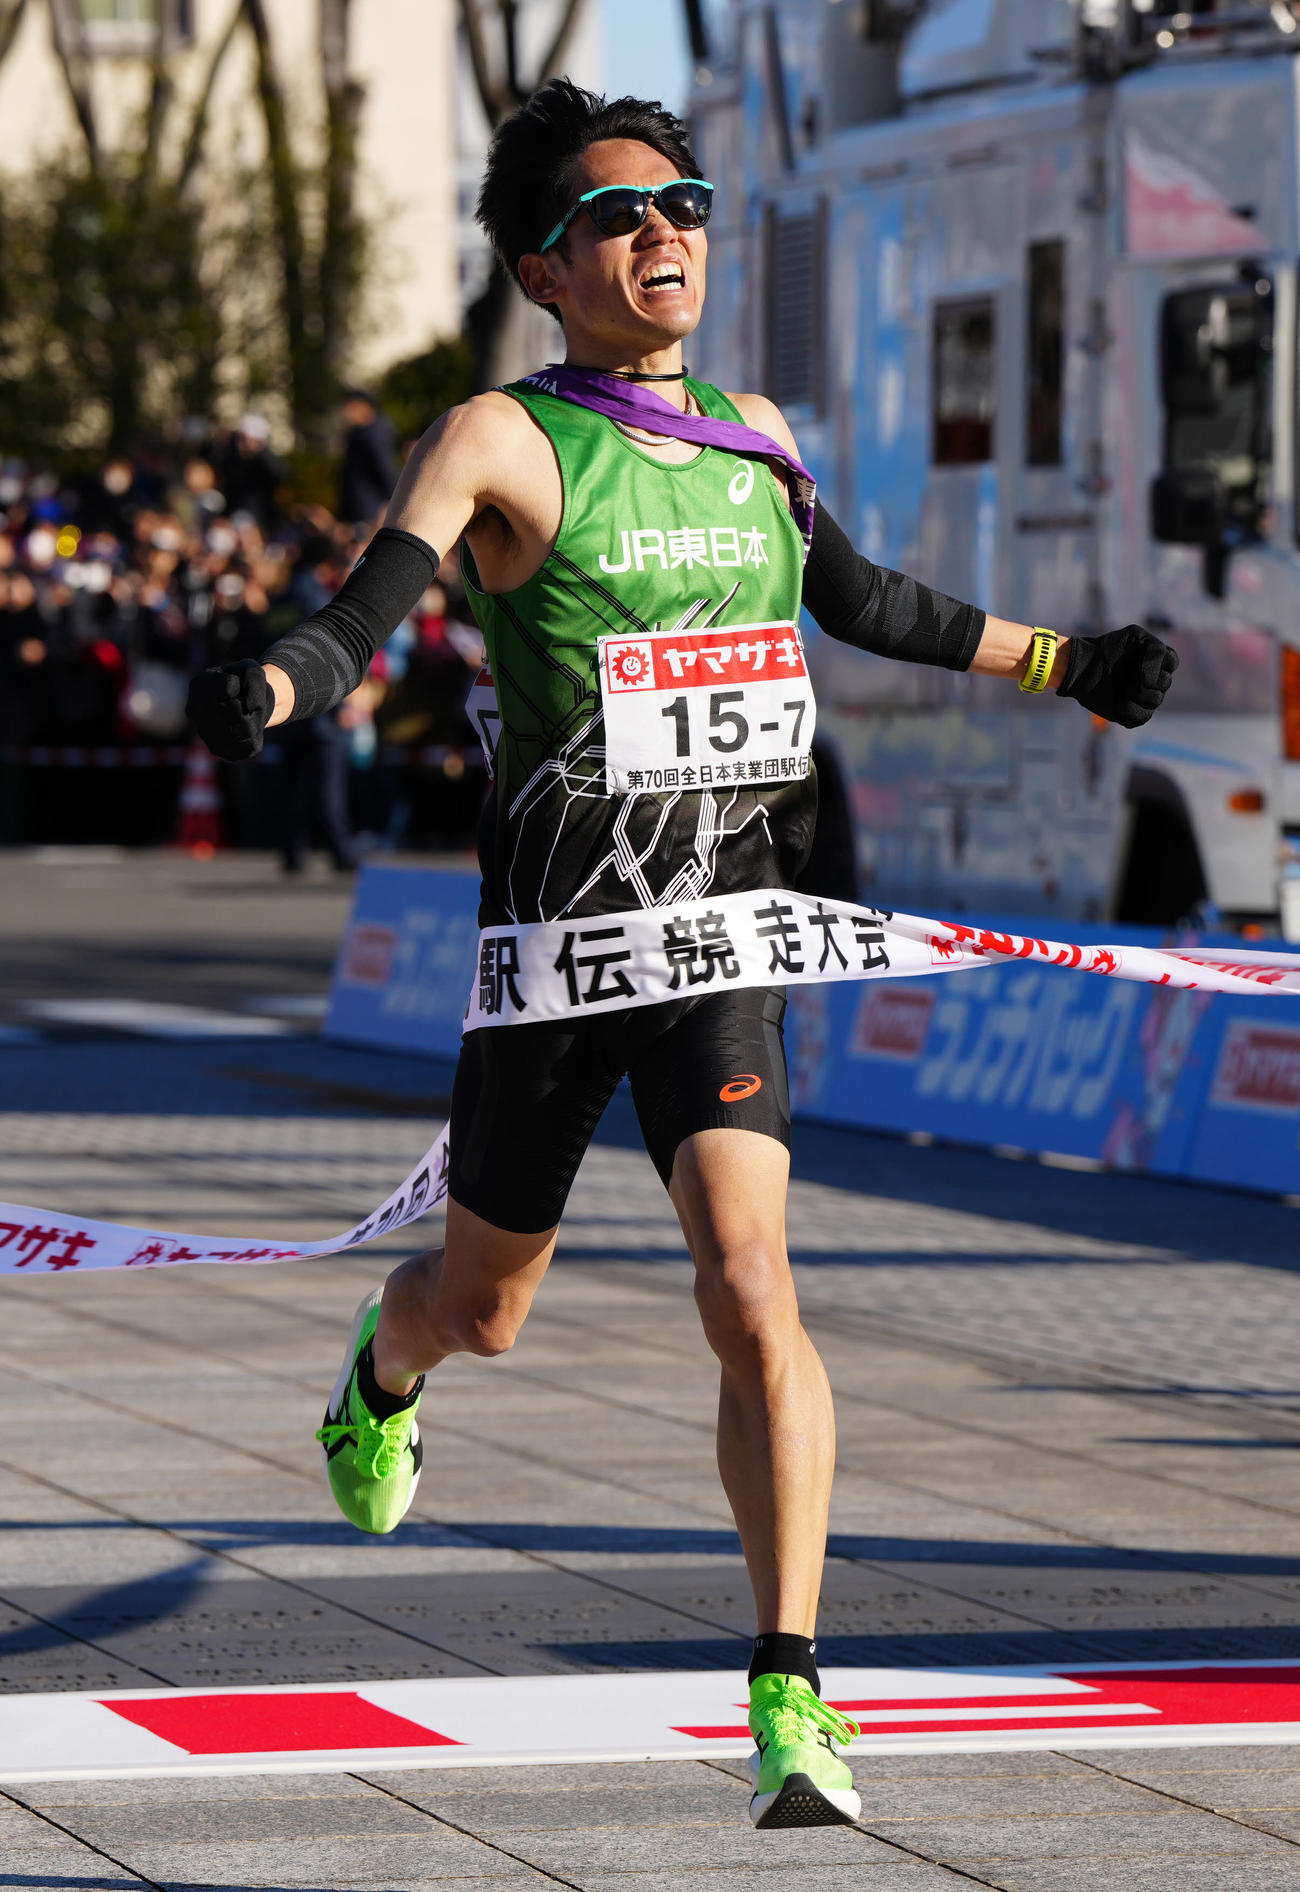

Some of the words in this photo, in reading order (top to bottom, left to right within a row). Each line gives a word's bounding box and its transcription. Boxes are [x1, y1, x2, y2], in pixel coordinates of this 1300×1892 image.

[598, 526, 770, 574] JR東日本
[662, 638, 802, 678] ヤマザキ
[661, 690, 806, 757] 15-7
[626, 756, 809, 791] 第70回全日本実業団駅伝
[464, 899, 891, 1020] 駅伝競走大会
